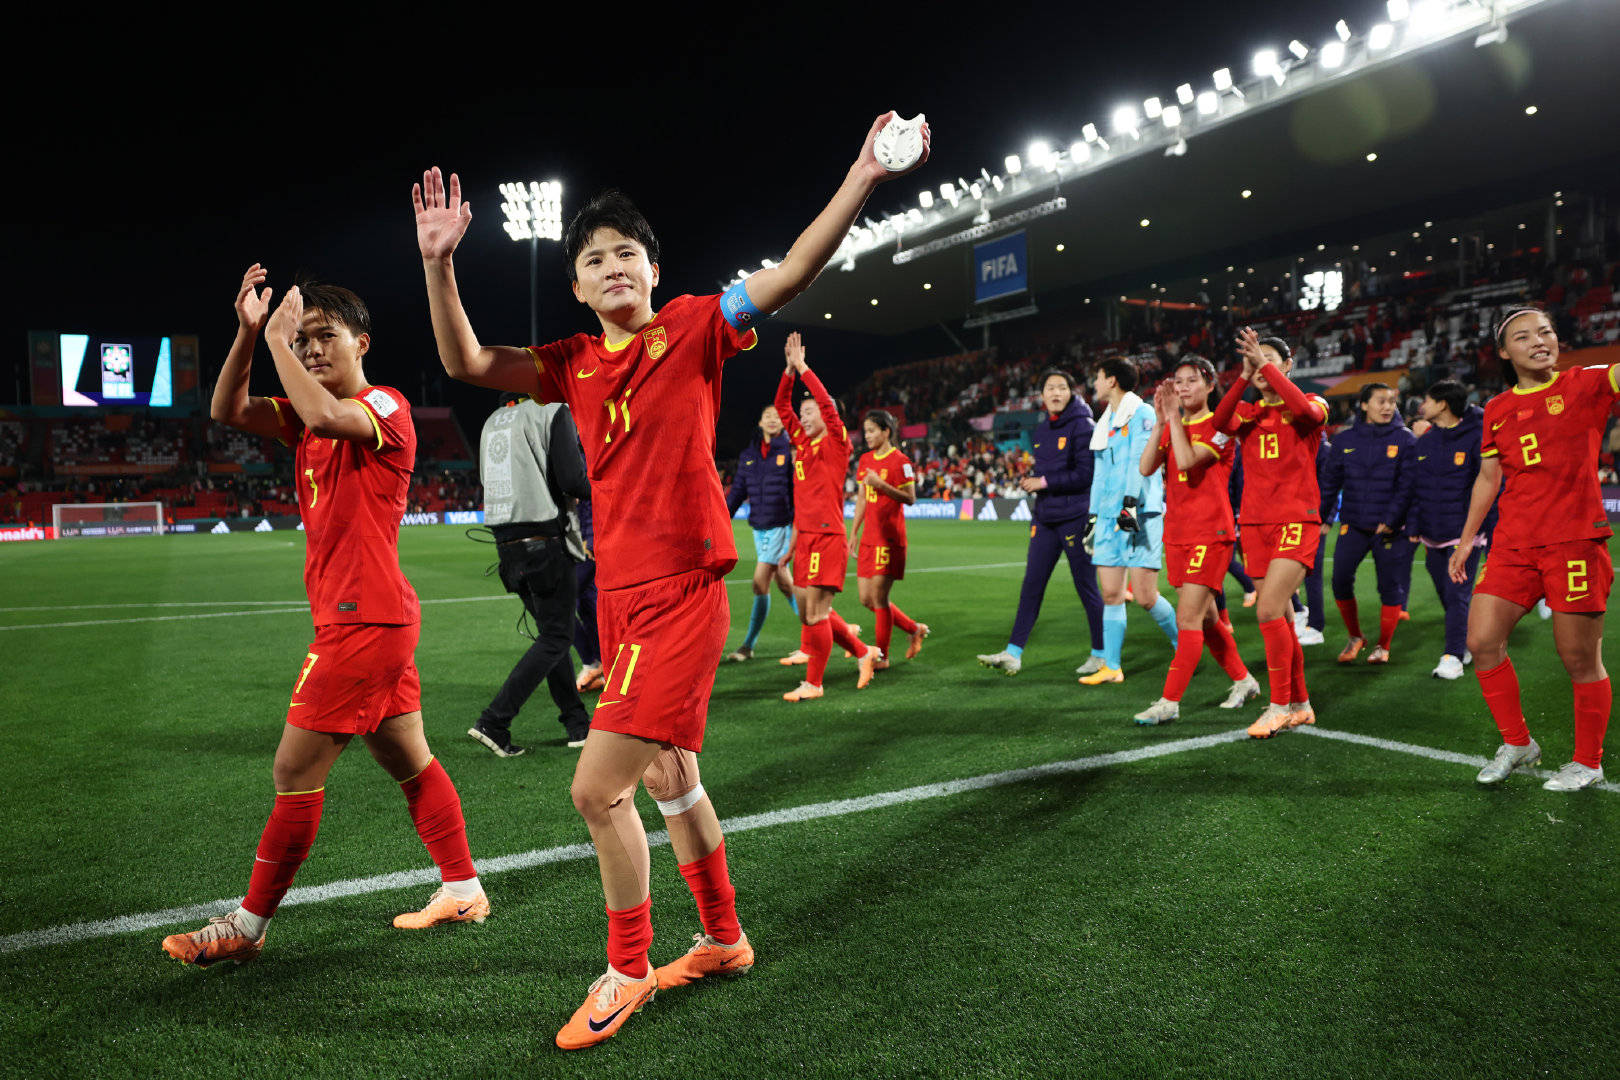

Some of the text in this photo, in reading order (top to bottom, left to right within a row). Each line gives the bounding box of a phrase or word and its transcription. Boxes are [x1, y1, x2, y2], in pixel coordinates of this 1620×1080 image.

[982, 252, 1018, 283] FIFA
[604, 387, 632, 444] 11
[1259, 433, 1279, 459] 13
[1519, 433, 1542, 466] 2
[795, 460, 806, 481] 8
[865, 485, 877, 502] 15
[401, 512, 438, 526] WAYS
[448, 511, 478, 524] VISA
[1280, 522, 1302, 546] 13
[809, 552, 820, 573] 8
[875, 546, 890, 564] 15
[1189, 545, 1207, 568] 3
[1567, 560, 1588, 592] 2
[296, 652, 319, 693] 7
[603, 643, 642, 696] 11
